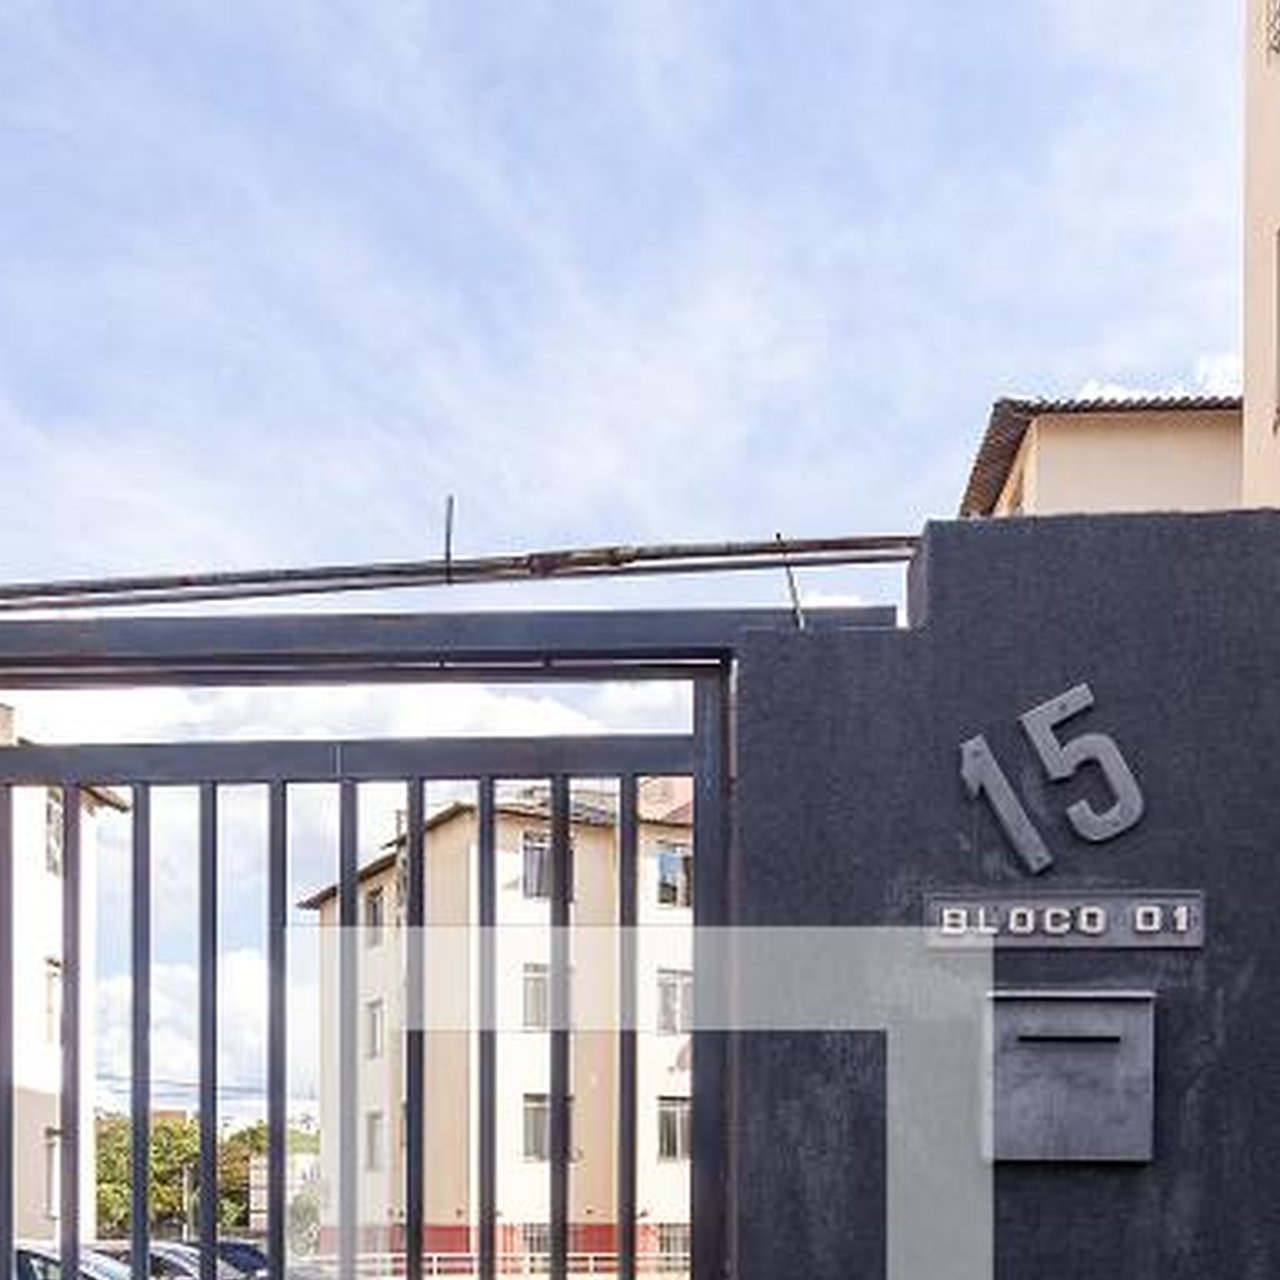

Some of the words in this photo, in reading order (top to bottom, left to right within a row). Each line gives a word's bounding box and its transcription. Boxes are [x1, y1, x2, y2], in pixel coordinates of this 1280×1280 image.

[959, 682, 1144, 873] 15
[941, 905, 1106, 935] BLOCO
[1135, 905, 1188, 932] 01
